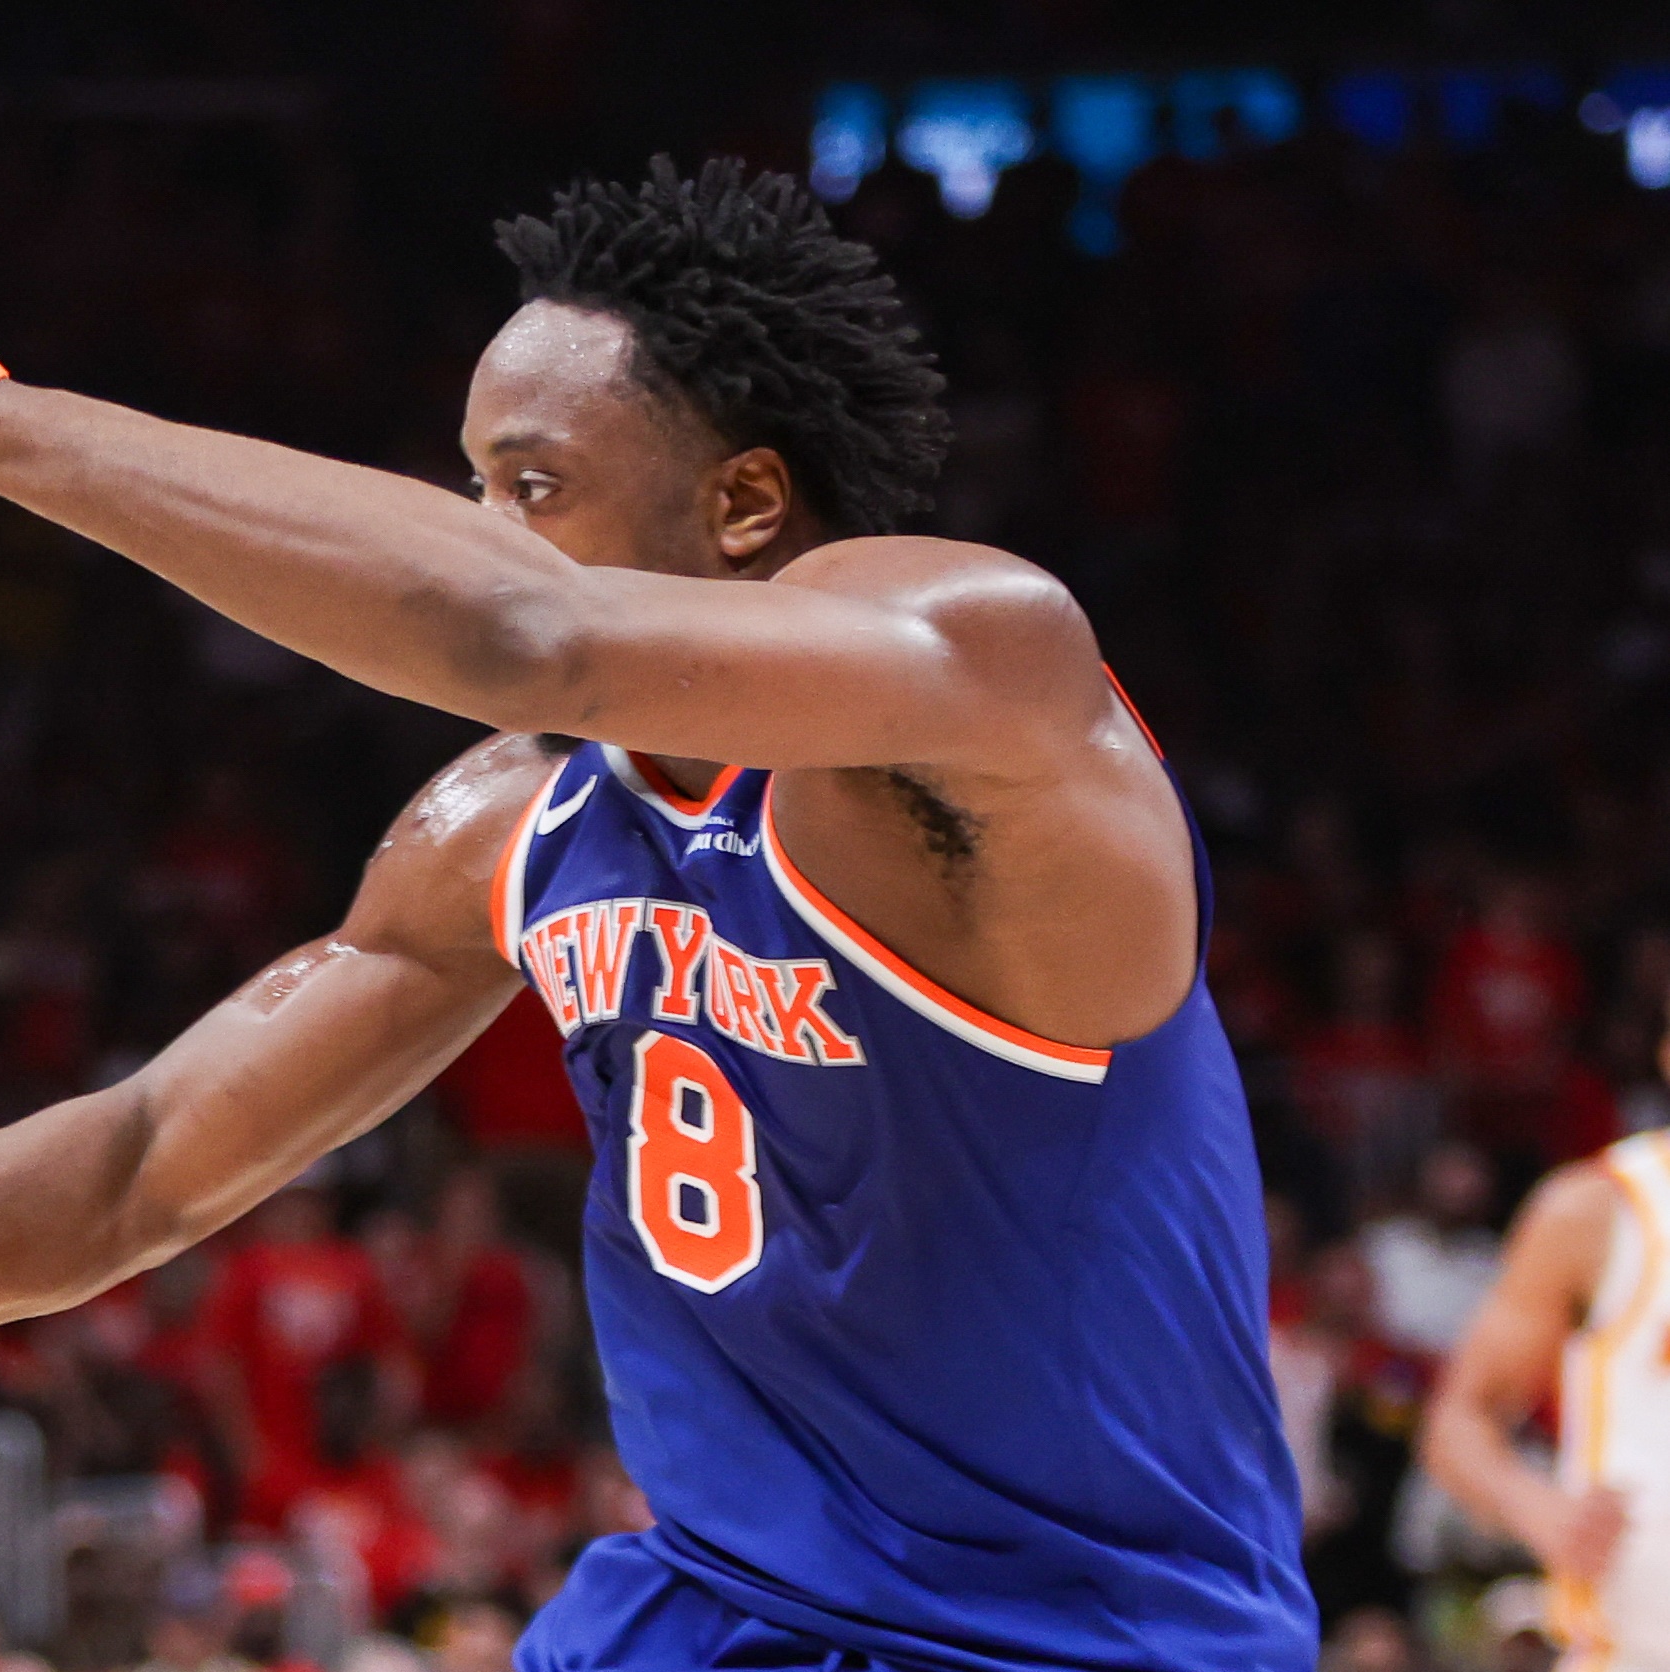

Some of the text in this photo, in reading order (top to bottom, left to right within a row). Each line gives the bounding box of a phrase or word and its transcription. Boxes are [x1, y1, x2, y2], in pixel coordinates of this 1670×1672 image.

[520, 897, 867, 1066] NEW YORK
[627, 1029, 764, 1294] 8
